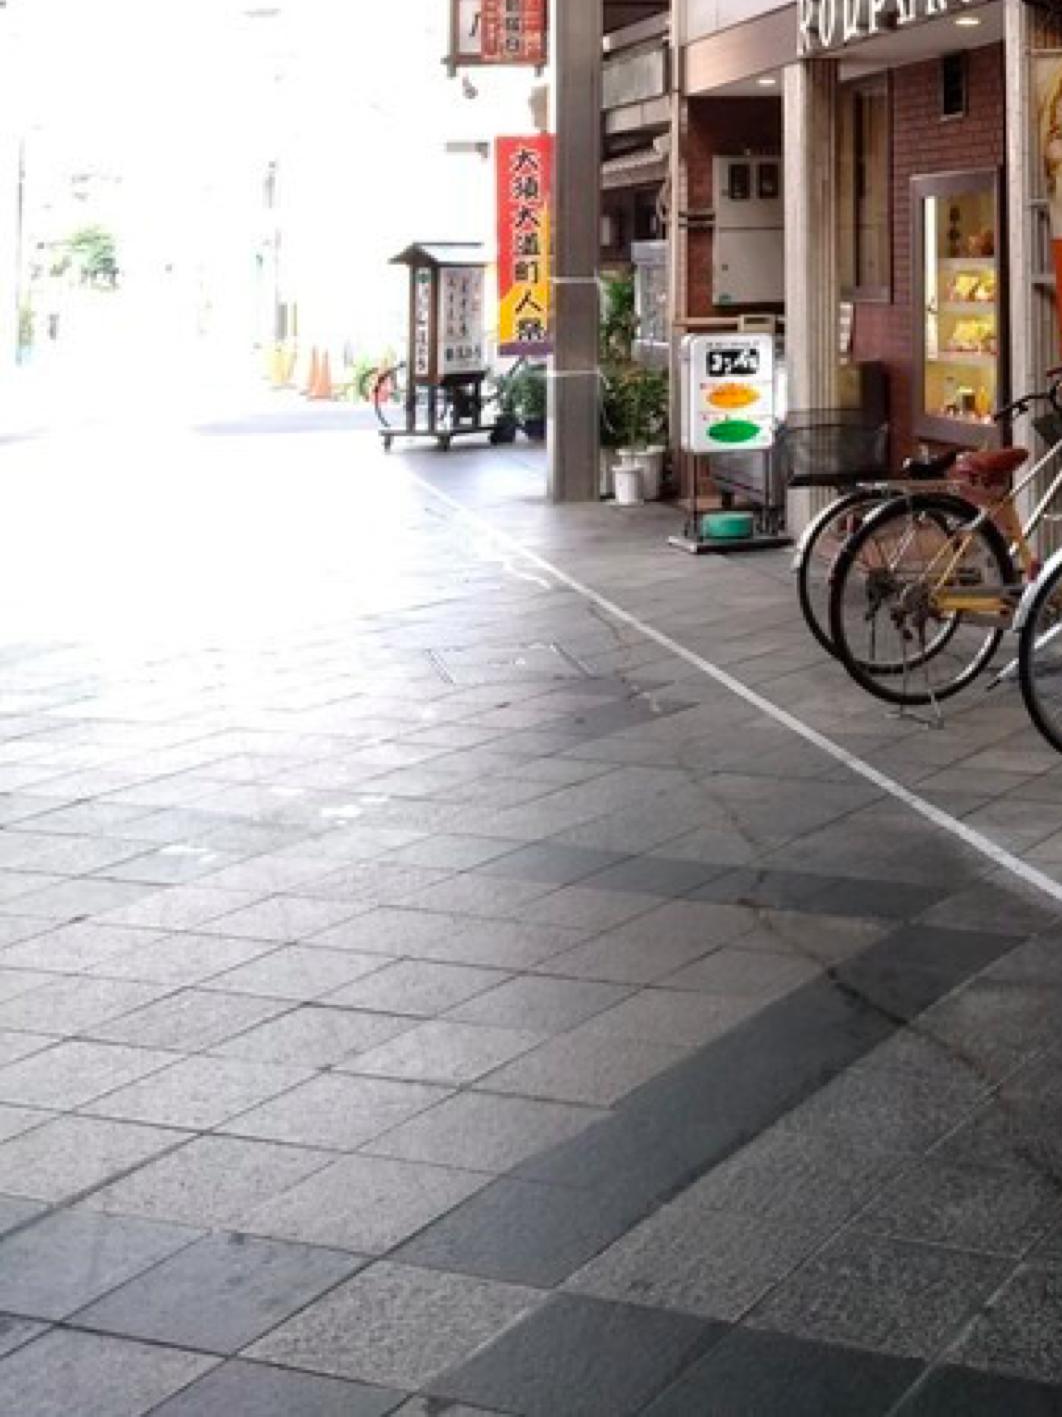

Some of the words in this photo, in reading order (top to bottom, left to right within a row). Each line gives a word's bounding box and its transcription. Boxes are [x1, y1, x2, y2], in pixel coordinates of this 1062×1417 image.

[513, 147, 543, 341] 大須大道町人祭
